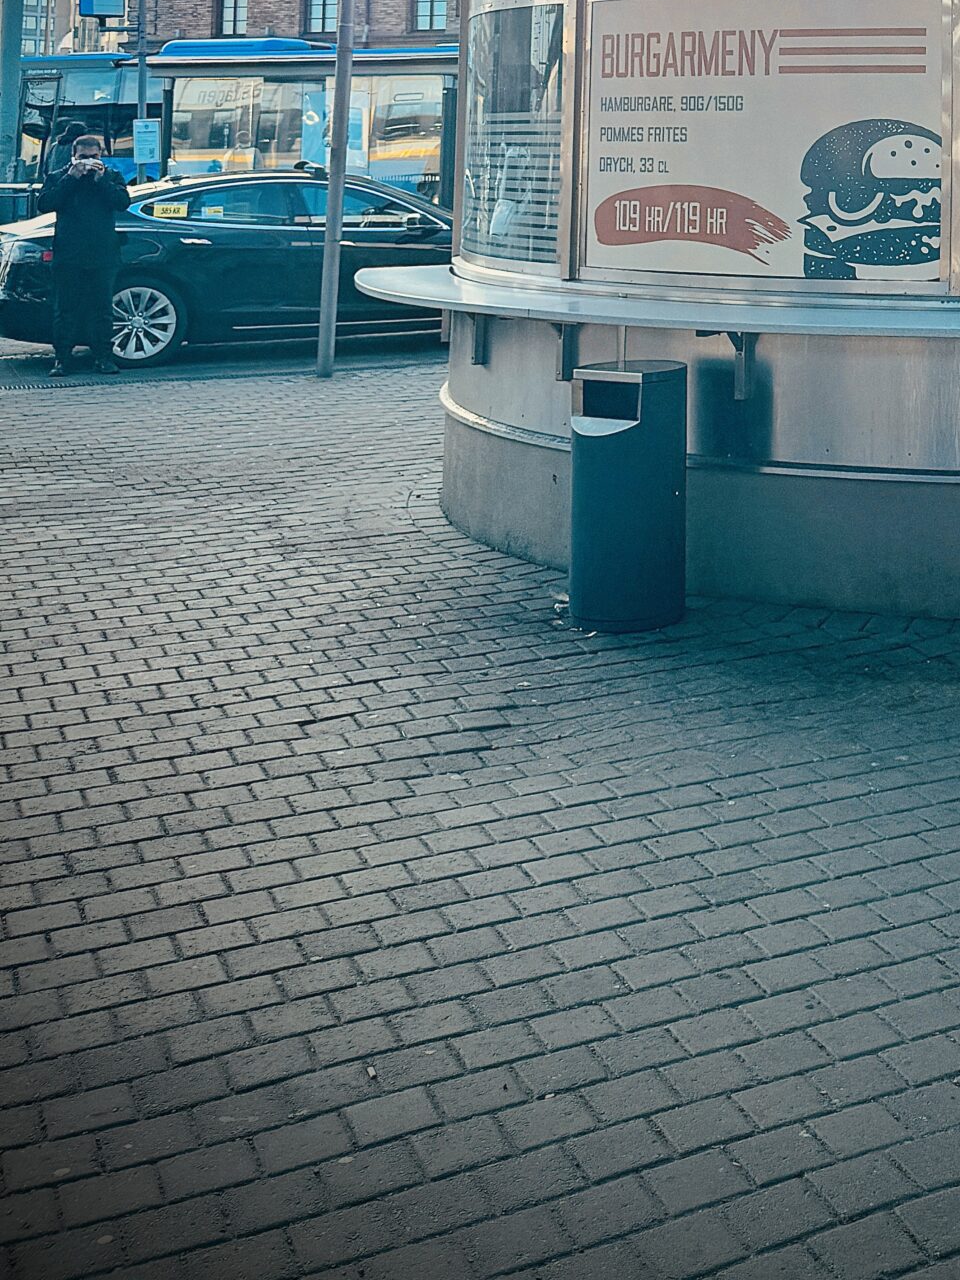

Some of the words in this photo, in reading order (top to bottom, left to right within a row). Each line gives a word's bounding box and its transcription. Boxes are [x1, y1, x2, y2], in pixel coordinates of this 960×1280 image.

[601, 29, 779, 79] BURGARMENY
[600, 96, 677, 113] HAMBURGARE,
[680, 95, 745, 112] 90G/150G
[600, 126, 644, 143] POMMES
[647, 126, 688, 142] FRITES
[639, 157, 654, 173] 33
[614, 200, 640, 232] 109
